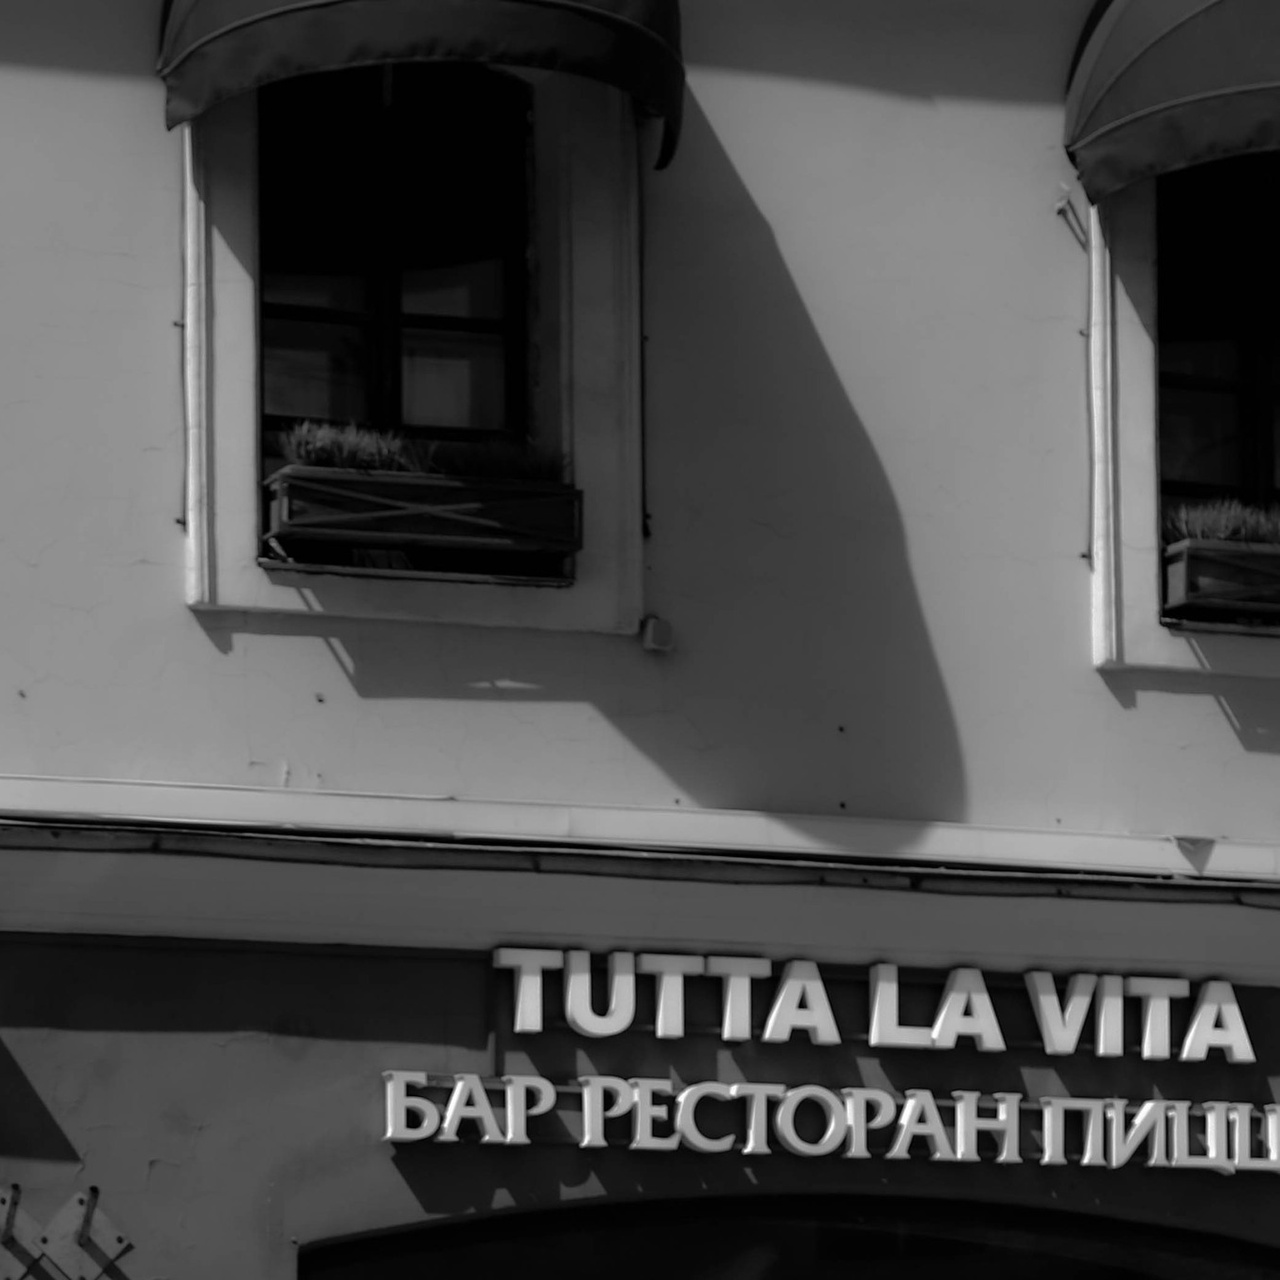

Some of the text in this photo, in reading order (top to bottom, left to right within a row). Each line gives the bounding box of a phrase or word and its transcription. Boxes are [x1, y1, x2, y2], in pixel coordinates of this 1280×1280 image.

[493, 946, 1256, 1063] TUTTA LA VITA
[382, 1070, 557, 1147] БАР
[578, 1075, 1023, 1164] РЕСТОРАН
